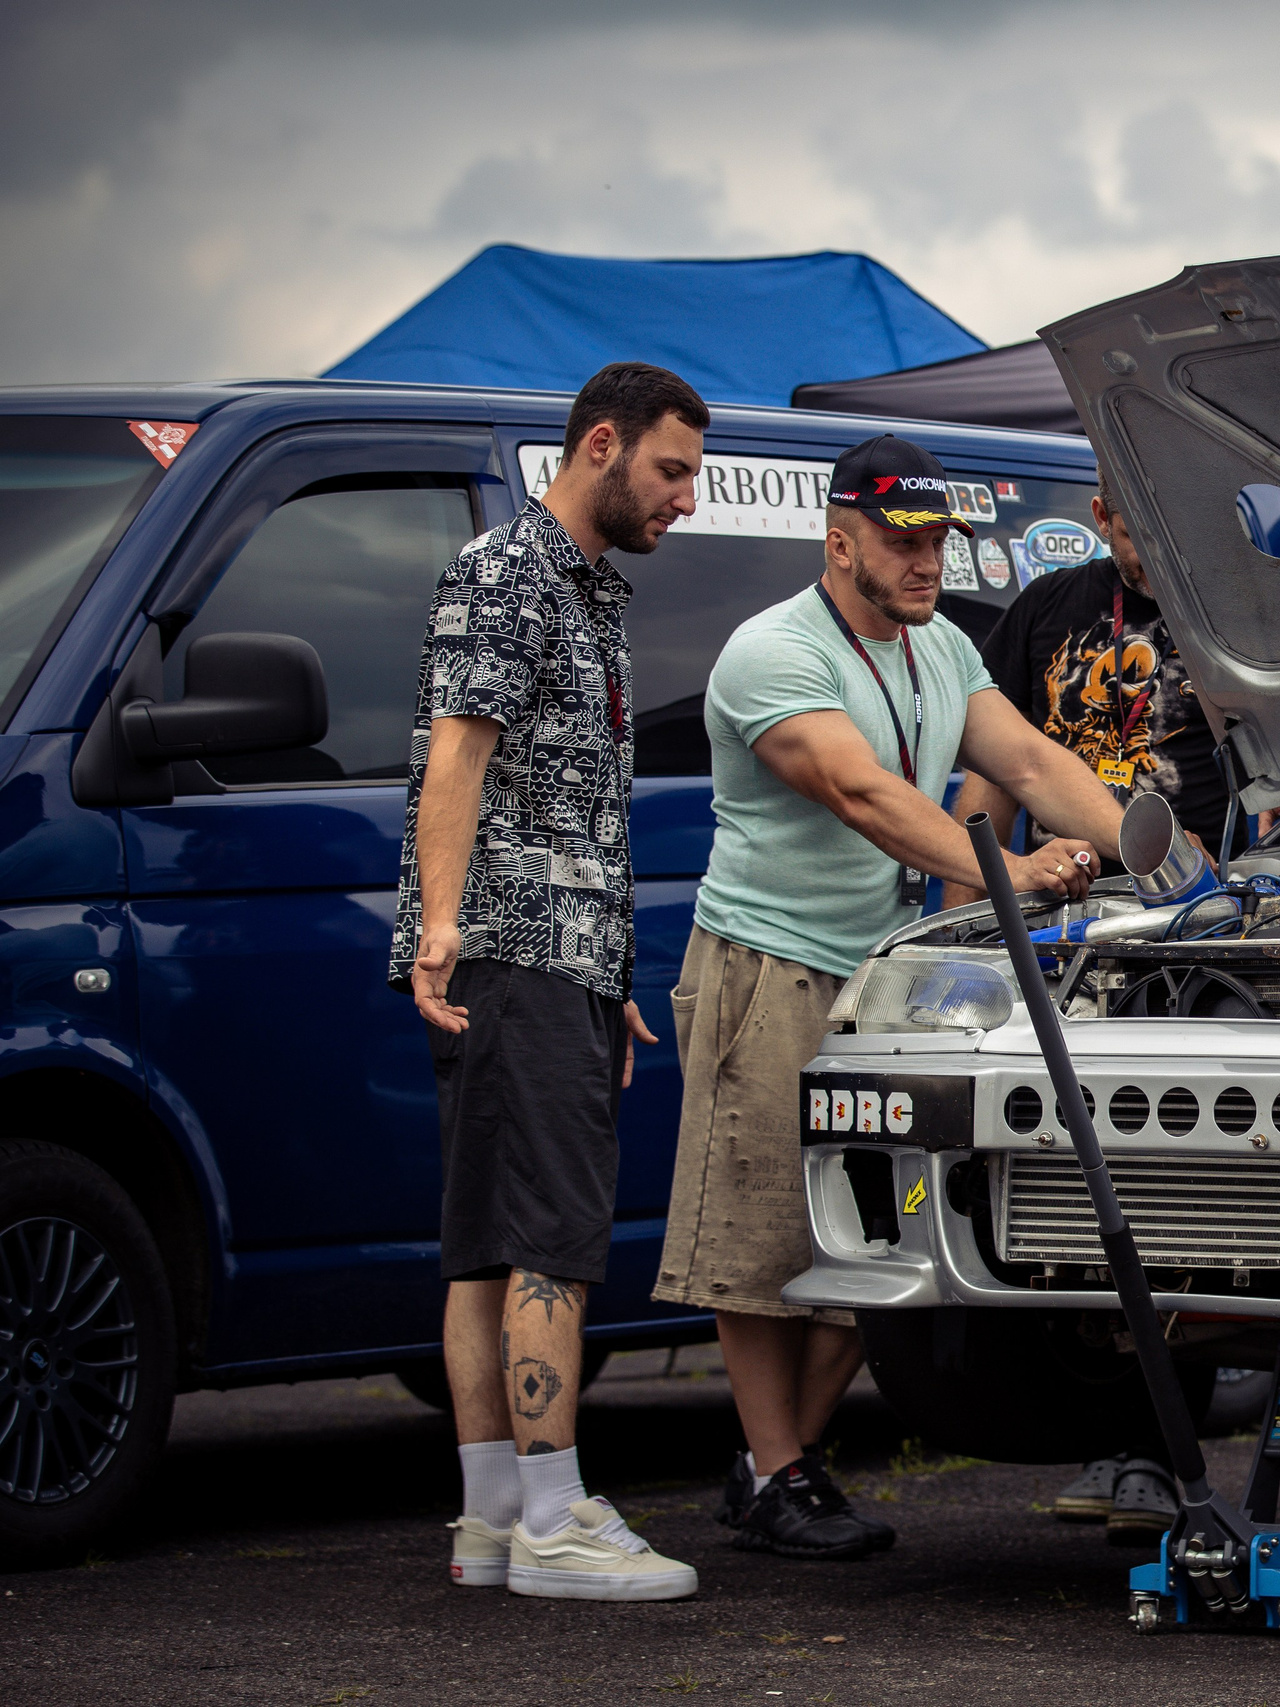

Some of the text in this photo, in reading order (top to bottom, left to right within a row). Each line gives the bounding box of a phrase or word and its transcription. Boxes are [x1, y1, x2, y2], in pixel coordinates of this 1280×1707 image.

[831, 492, 856, 501] ADVAN
[1046, 536, 1086, 555] ORC
[809, 1089, 913, 1134] RDRC
